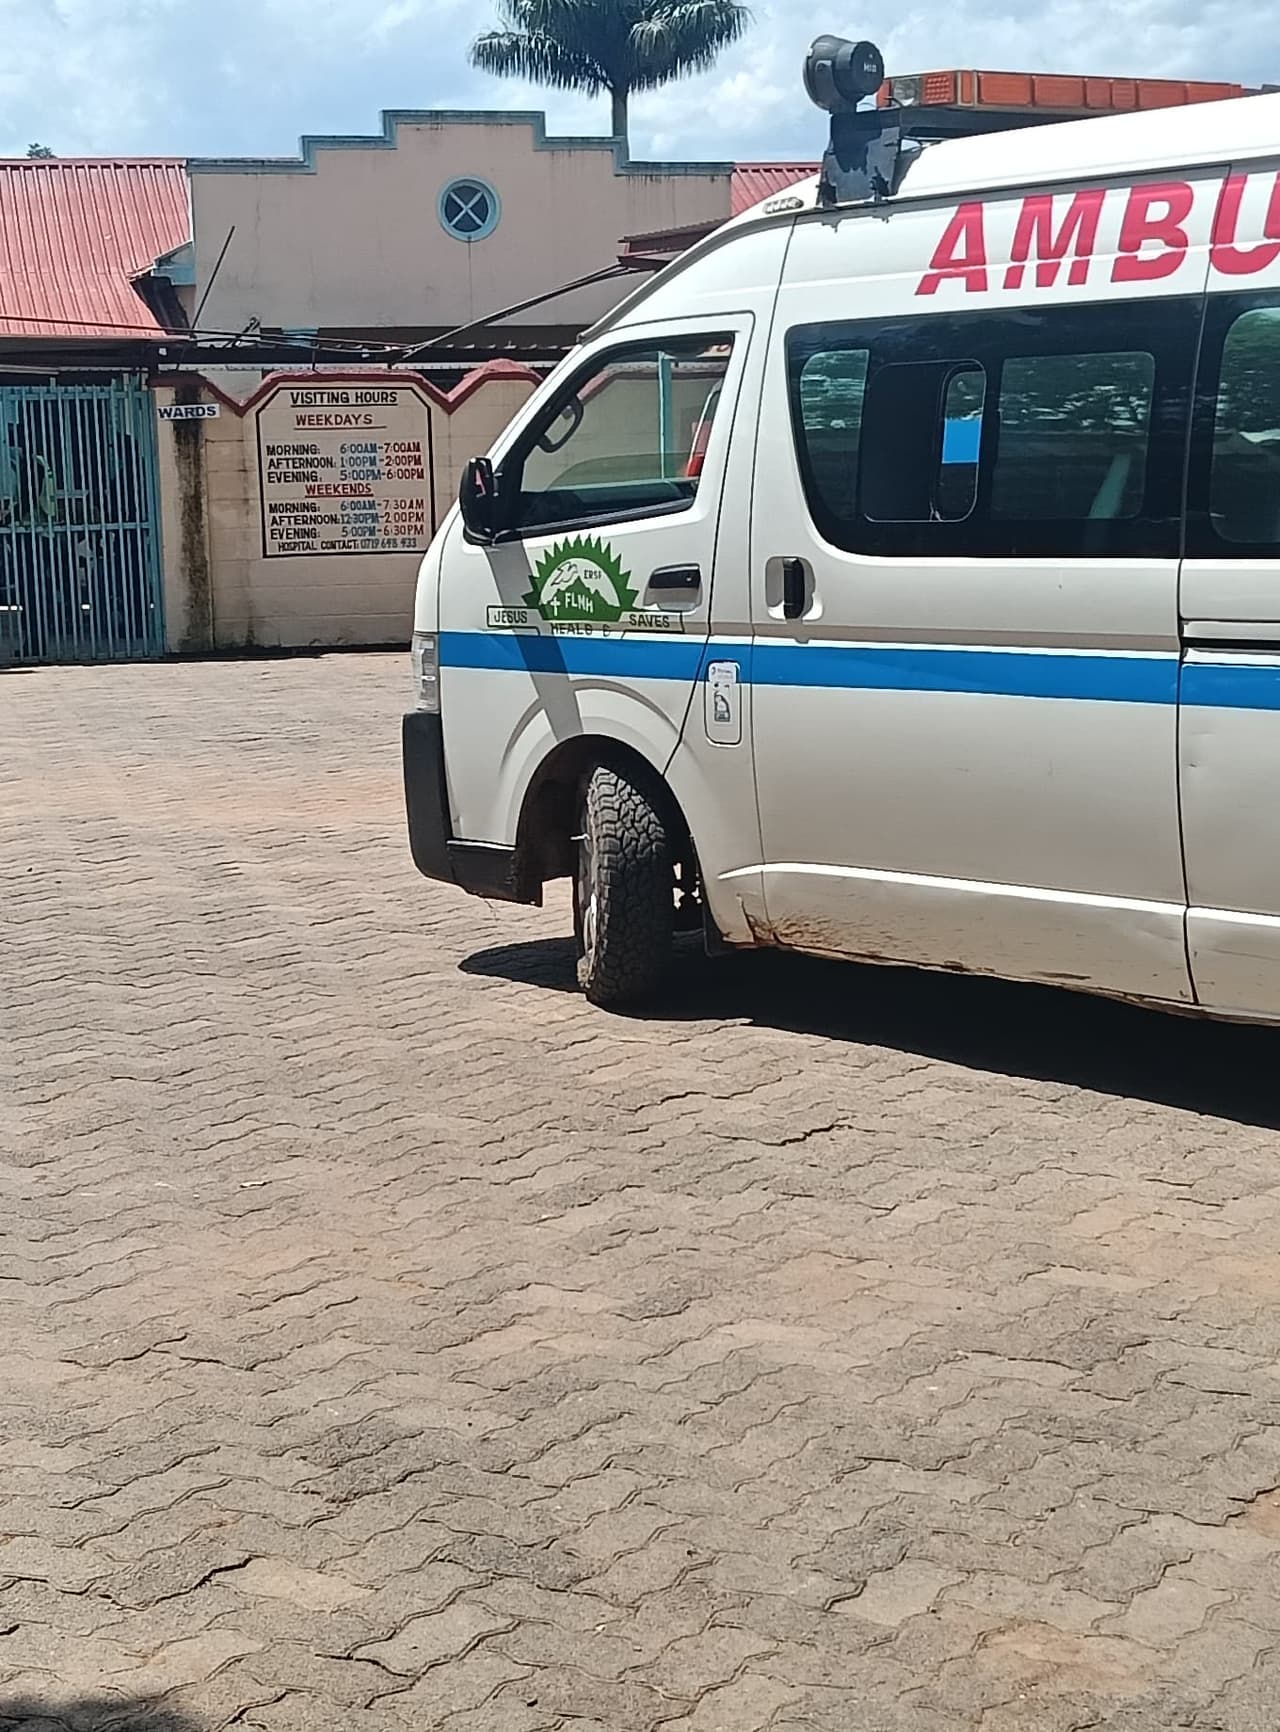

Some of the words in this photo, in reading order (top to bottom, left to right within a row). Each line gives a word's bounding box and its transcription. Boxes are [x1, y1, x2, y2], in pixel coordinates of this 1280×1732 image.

[290, 391, 350, 404] VISITING
[355, 391, 398, 403] HOURS
[158, 406, 217, 418] WARDS
[295, 413, 373, 426] WEEKDAYS
[266, 443, 321, 457] MORNING:
[268, 456, 337, 470] AFTERNOON:
[267, 470, 323, 484] EVENING:
[305, 483, 372, 495] WEEKENDS
[269, 502, 321, 514] MORNING:
[270, 526, 321, 540] EVENING:
[277, 540, 318, 552] HOSPITAL
[565, 591, 594, 614] FLNH
[493, 610, 528, 624] JESUS
[629, 613, 670, 628] SAVES
